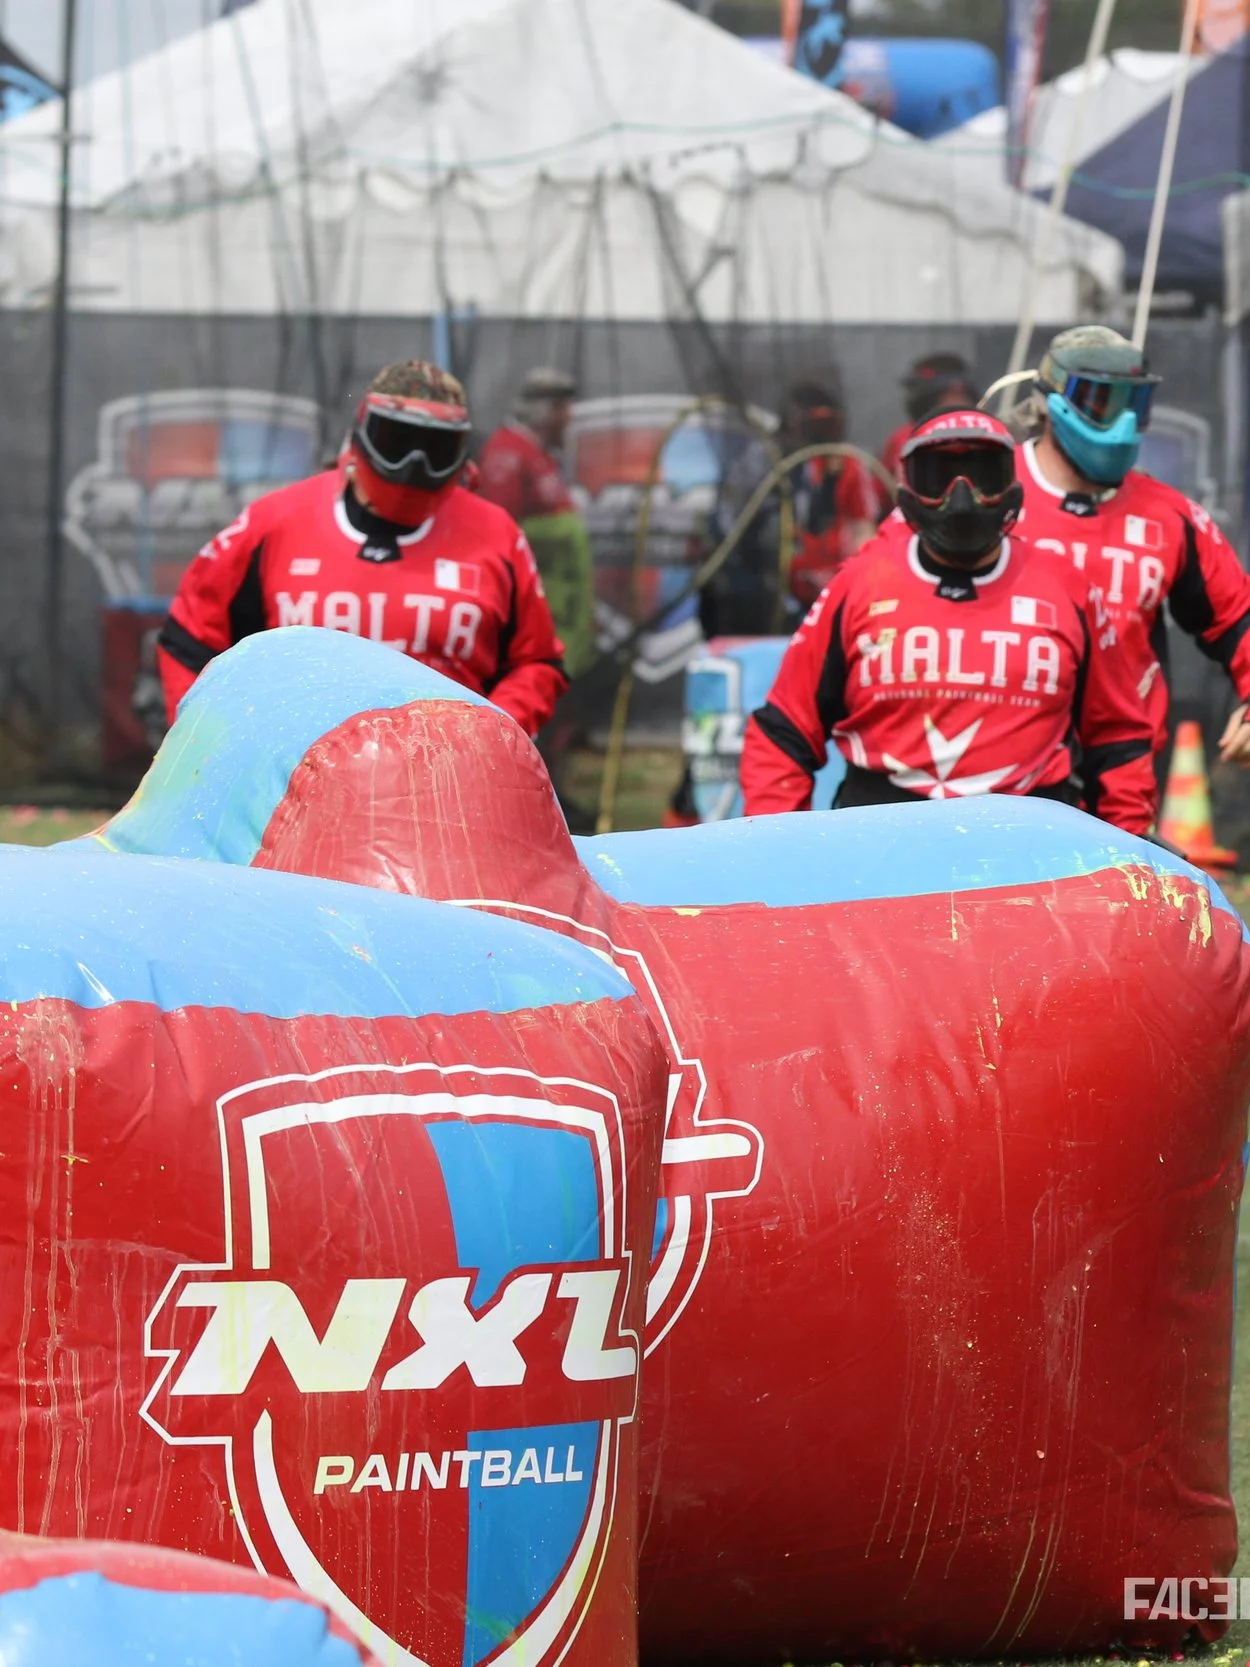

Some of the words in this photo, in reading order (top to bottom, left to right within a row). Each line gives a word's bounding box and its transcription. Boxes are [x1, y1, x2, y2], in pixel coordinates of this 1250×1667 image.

[275, 591, 482, 661] MALTA
[856, 626, 1061, 695] MALTA
[170, 1269, 637, 1396] NXL
[314, 1445, 583, 1495] PAINTBALL
